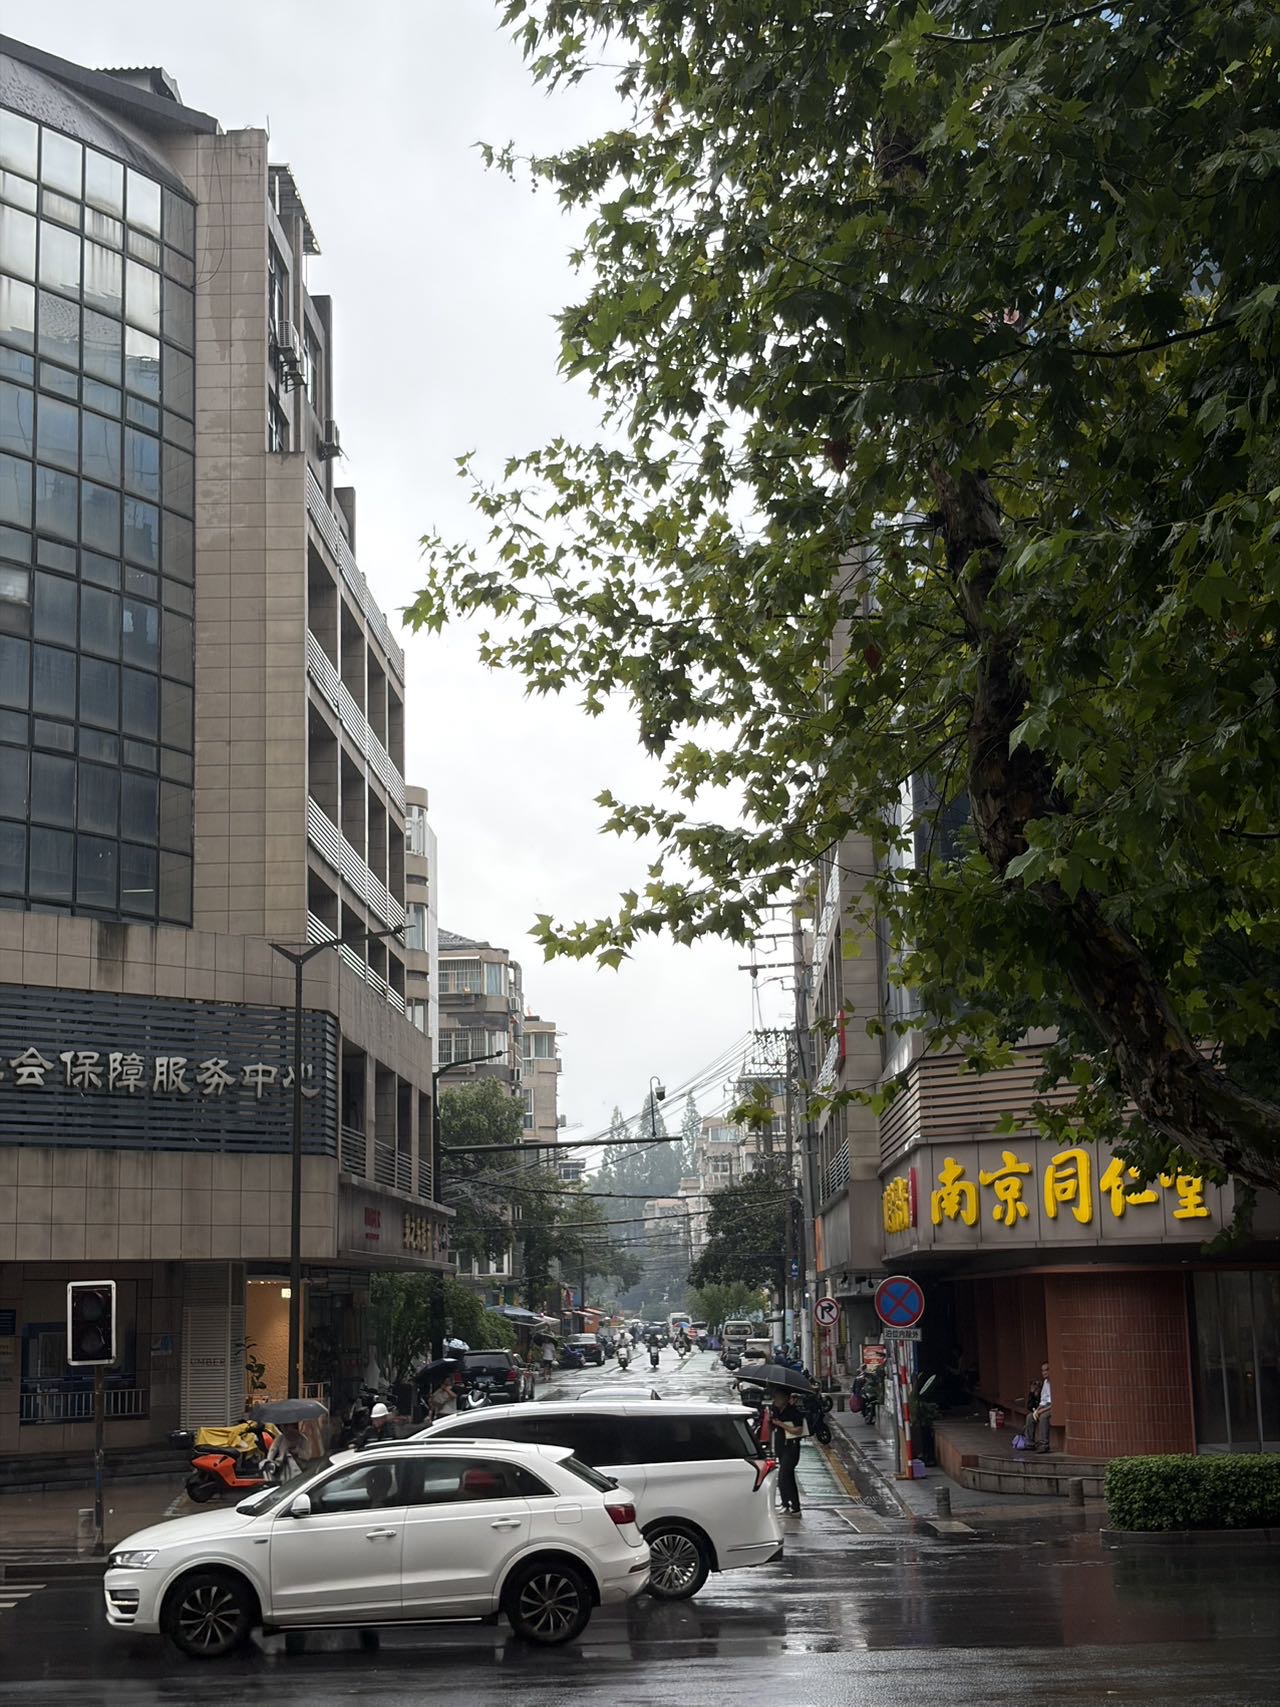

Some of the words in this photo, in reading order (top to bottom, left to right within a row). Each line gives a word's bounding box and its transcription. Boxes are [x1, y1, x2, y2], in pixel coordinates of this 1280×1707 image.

[0, 1047, 320, 1098] 会保障服务中心
[931, 1148, 1211, 1227] 南京同仁堂
